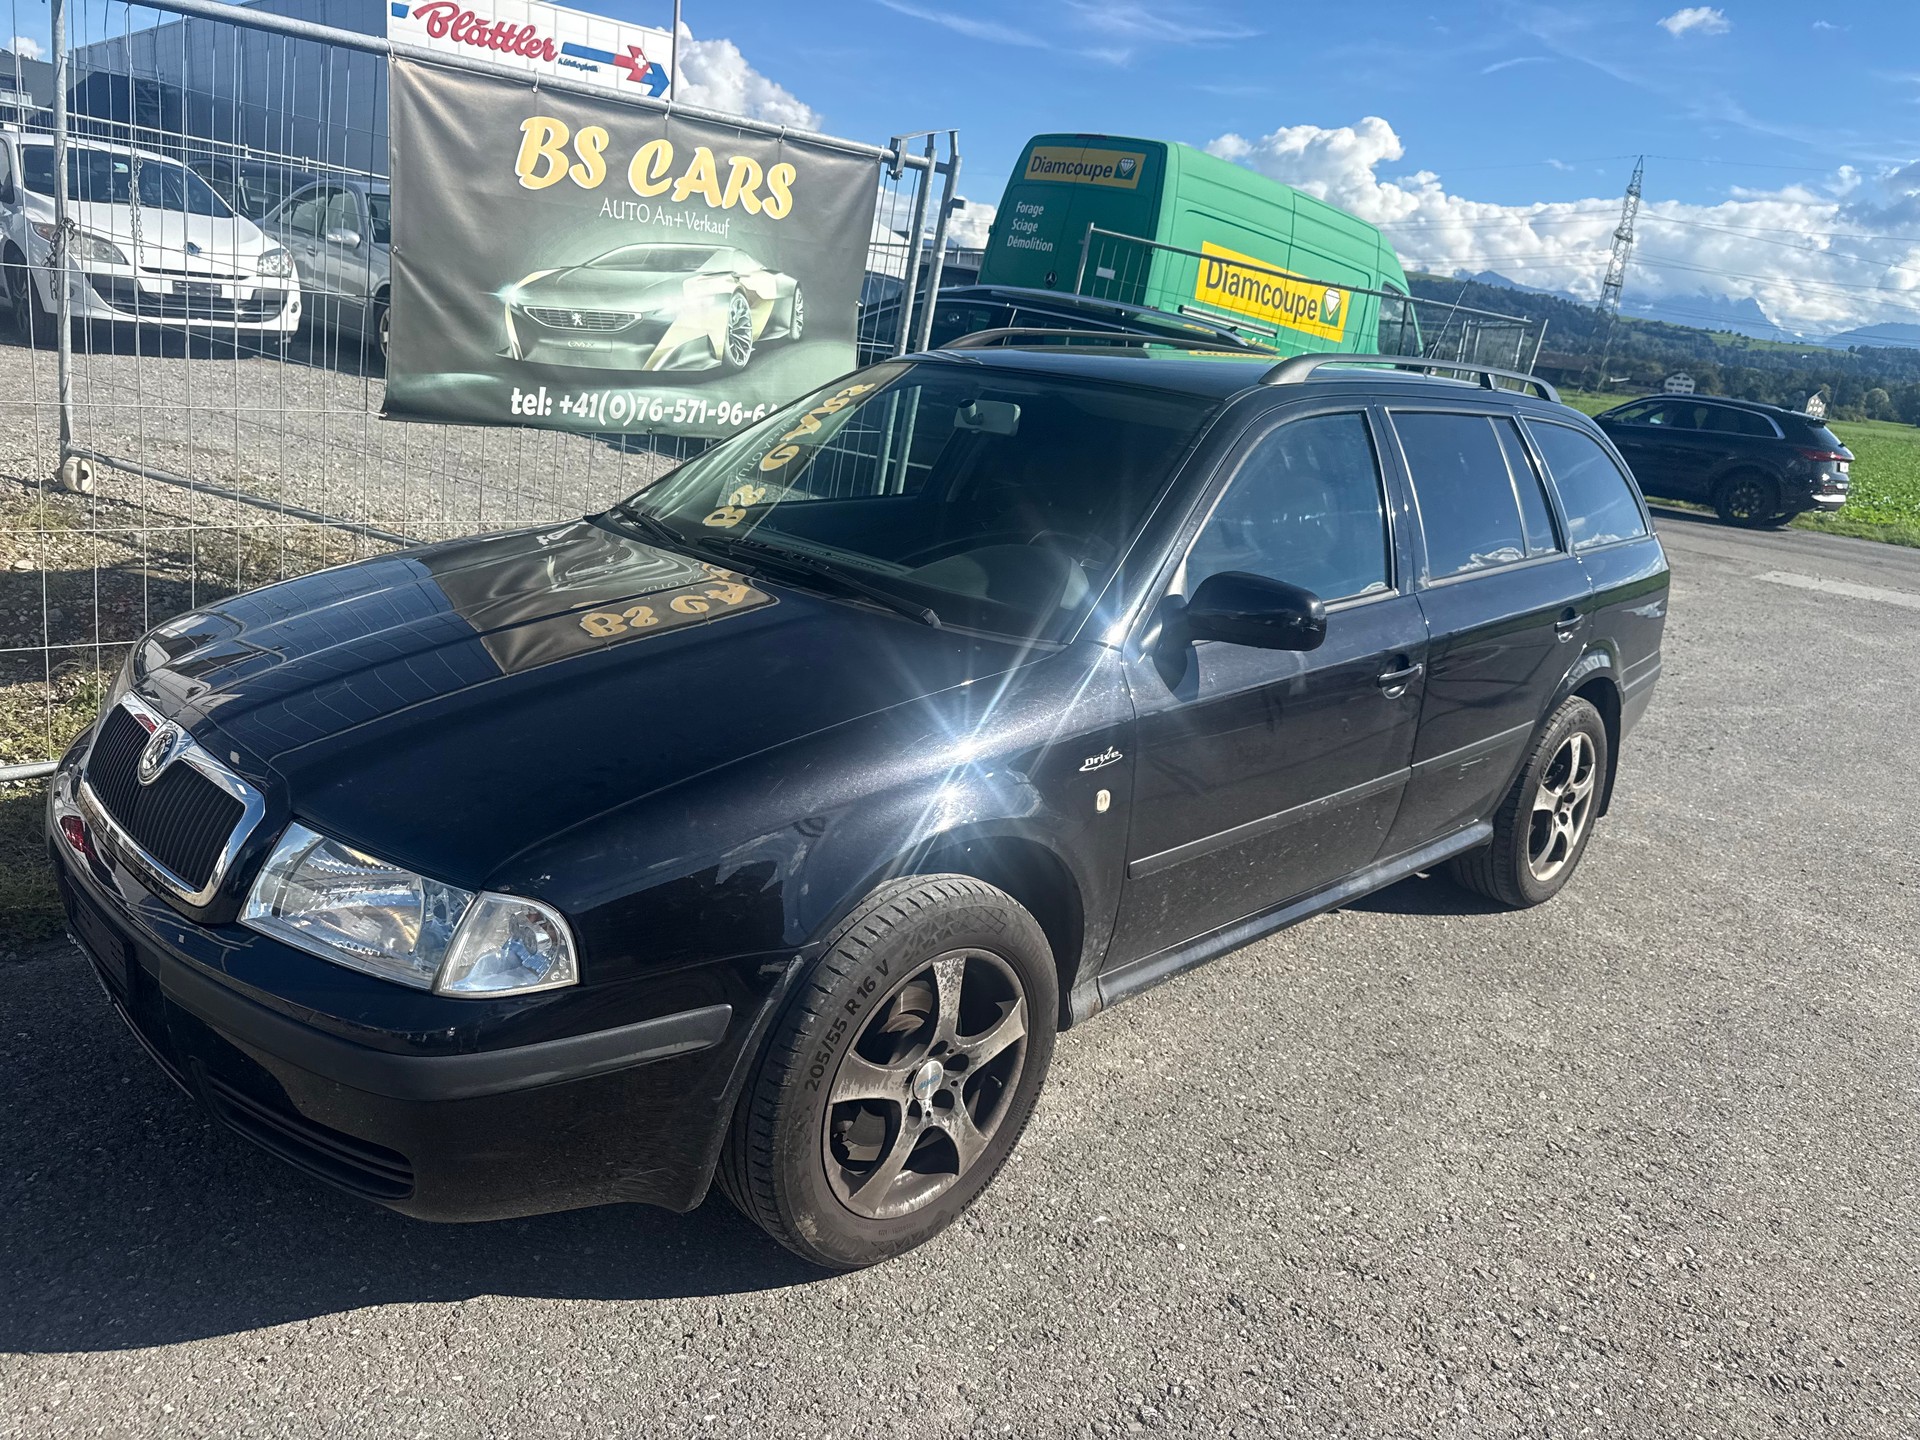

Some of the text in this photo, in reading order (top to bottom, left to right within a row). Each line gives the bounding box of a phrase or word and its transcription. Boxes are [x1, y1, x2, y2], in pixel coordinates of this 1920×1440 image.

[413, 1, 558, 62] Blättler
[514, 116, 797, 220] BS CARS
[1030, 155, 1113, 181] Diamcoupe
[598, 197, 731, 239] AUTO An+Verkauf
[1015, 201, 1044, 217] Forage
[1012, 218, 1039, 234] Sciage
[1007, 235, 1053, 253] Démolition
[1205, 256, 1319, 324] Diamcoupe
[511, 386, 552, 417] tel:
[1082, 745, 1121, 769] Drive
[804, 958, 891, 1093] 205/55 R 16 V
